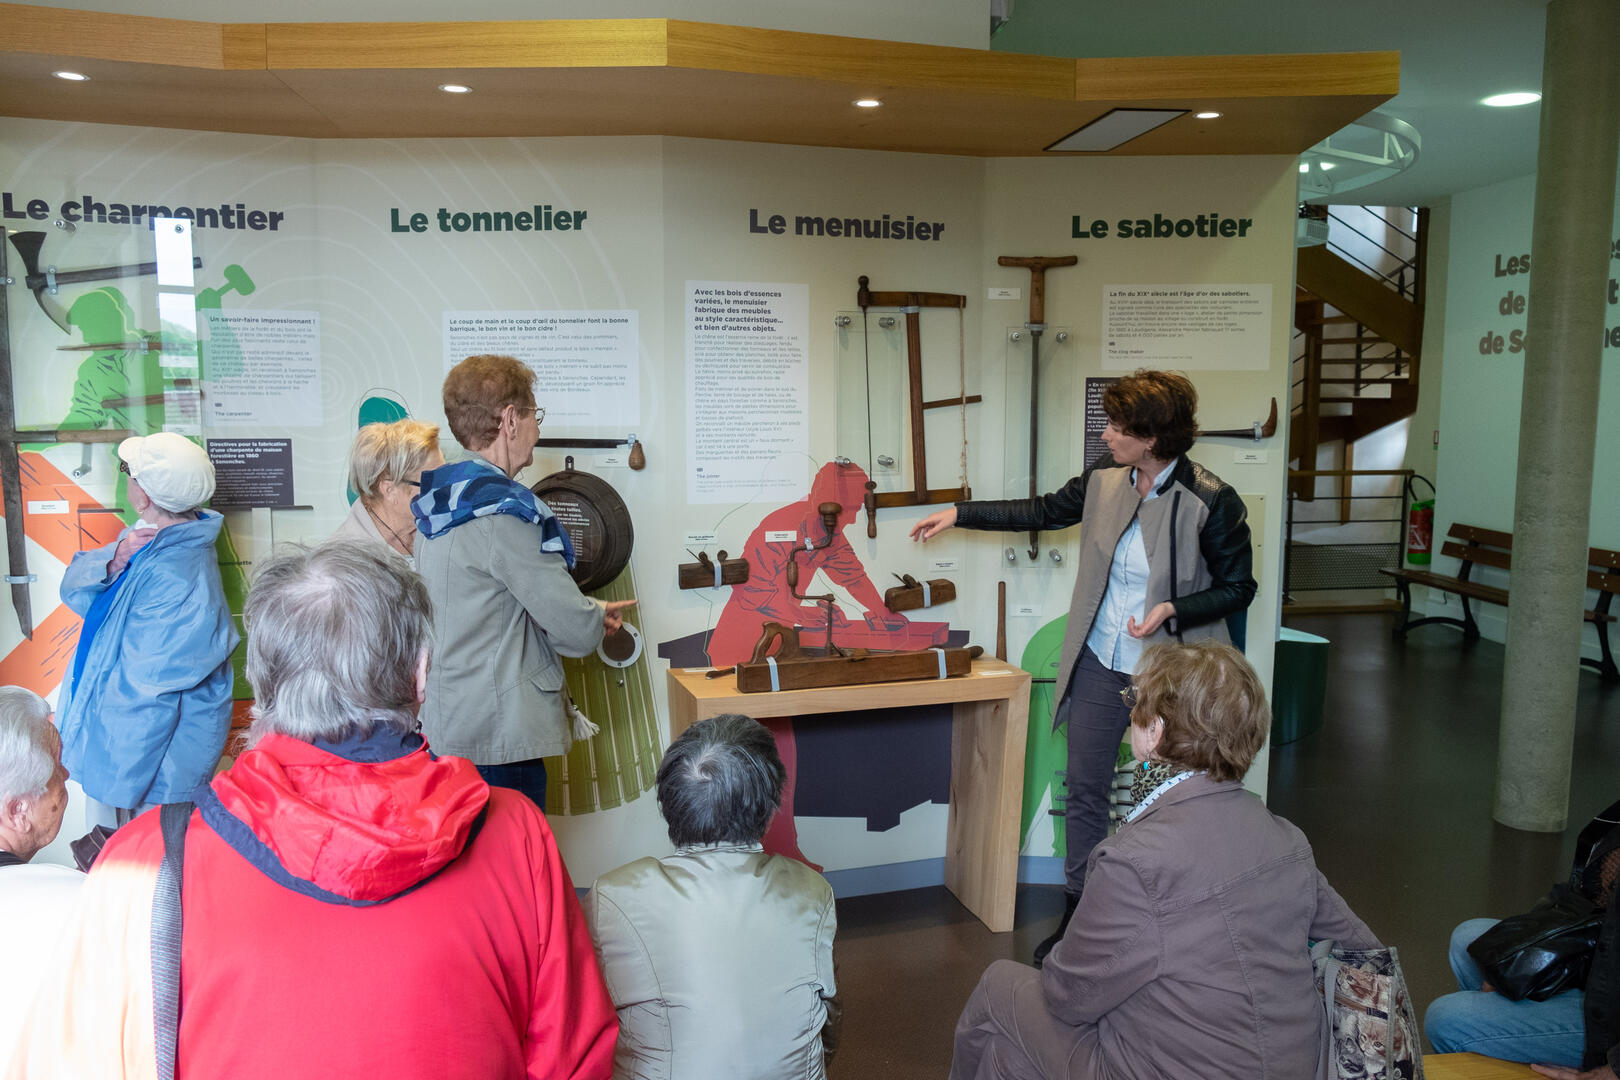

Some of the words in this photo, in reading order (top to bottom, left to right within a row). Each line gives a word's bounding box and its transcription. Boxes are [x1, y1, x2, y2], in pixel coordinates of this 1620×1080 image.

[2, 192, 50, 219] Le
[60, 195, 284, 231] charpentier
[391, 208, 428, 233] Le
[437, 205, 588, 232] tonnelier
[749, 208, 787, 235] Le
[795, 211, 944, 241] menuisier
[1072, 215, 1109, 239] Le
[1116, 212, 1252, 238] sabotier
[1494, 253, 1530, 278] Les
[752, 325, 776, 333] objets.
[1479, 330, 1504, 355] de
